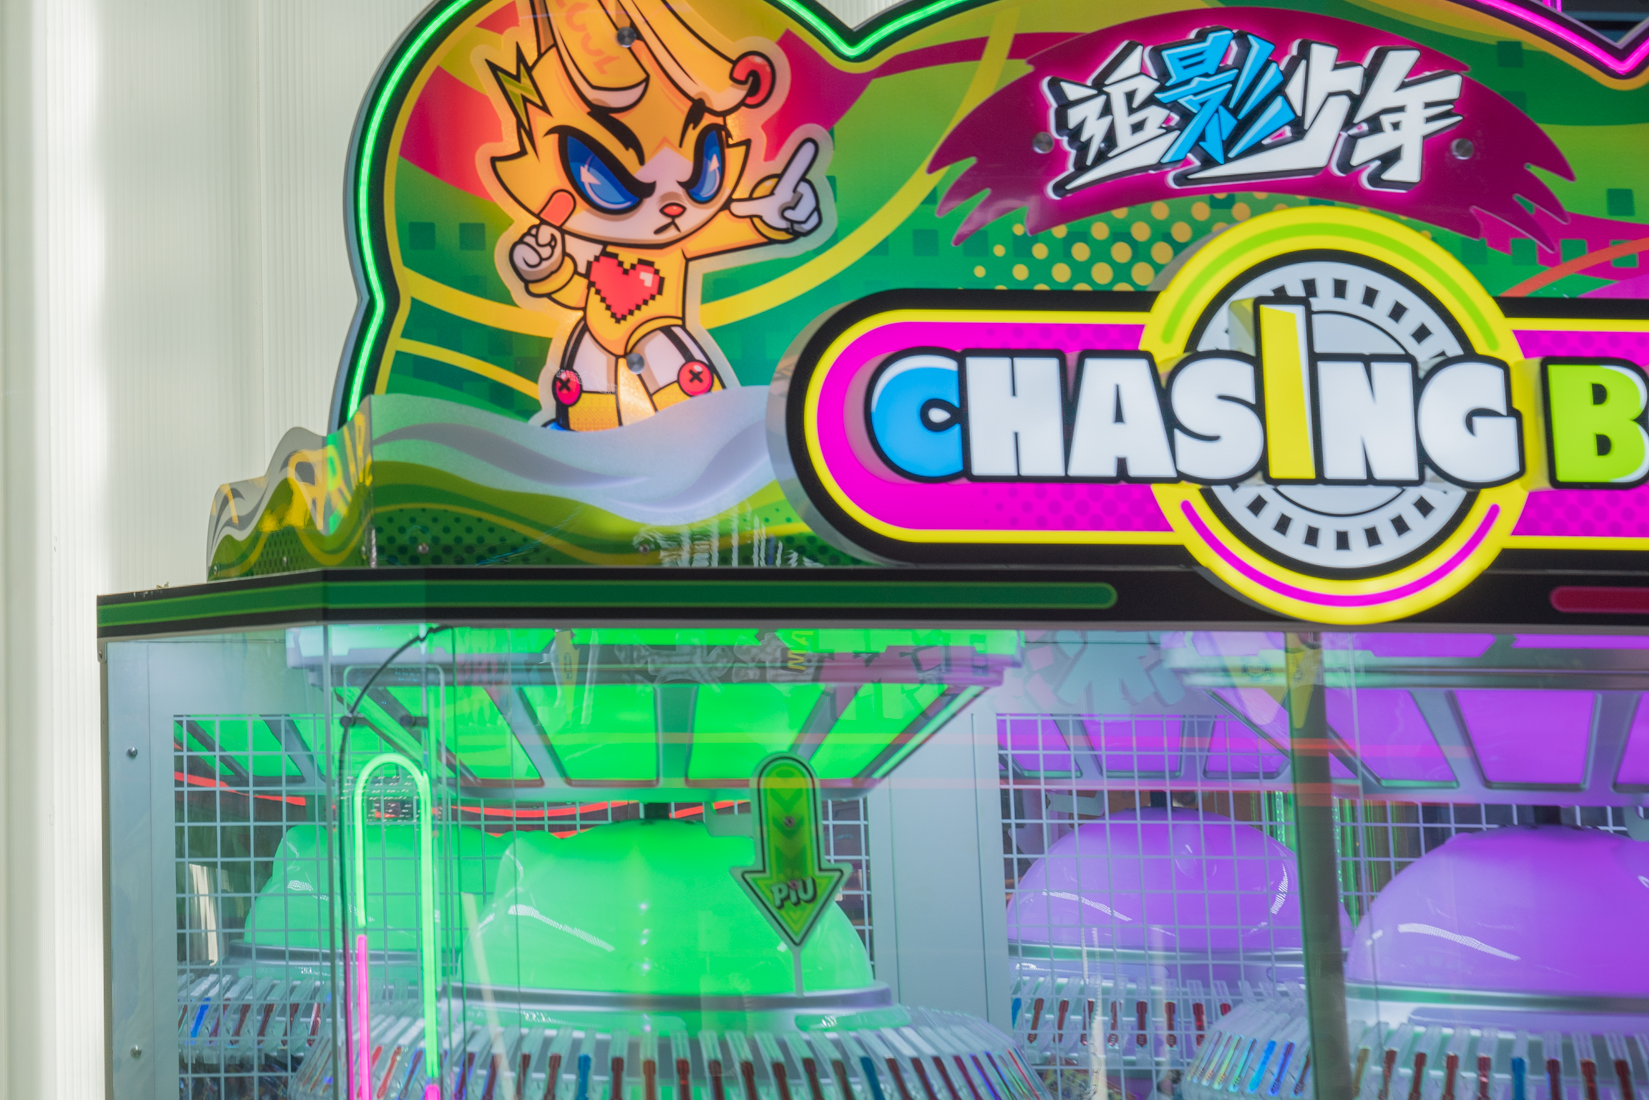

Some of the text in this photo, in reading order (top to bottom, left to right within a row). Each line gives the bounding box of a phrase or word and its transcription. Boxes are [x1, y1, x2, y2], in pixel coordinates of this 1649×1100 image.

[1046, 28, 1464, 194] 追影少年
[867, 300, 1524, 487] CHASING
